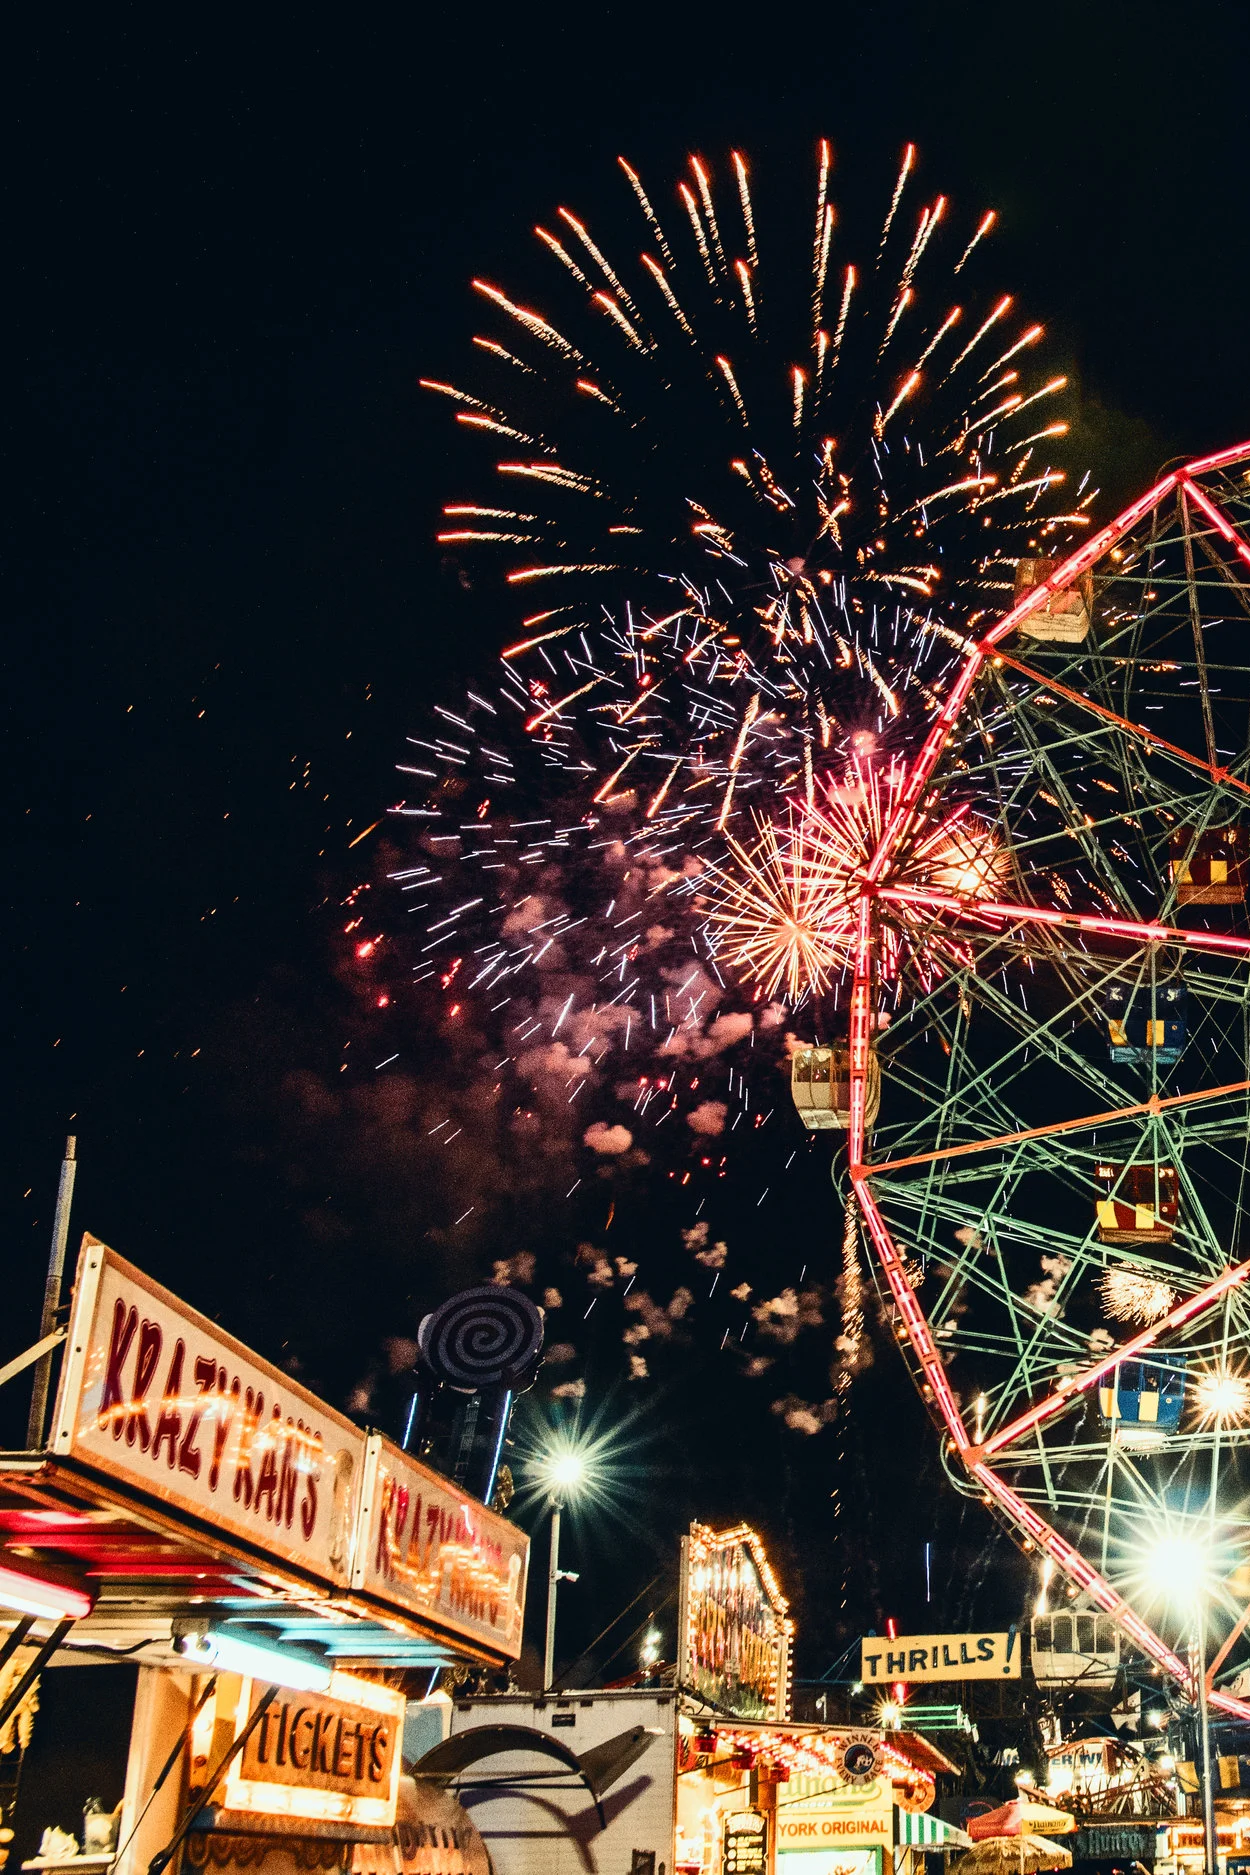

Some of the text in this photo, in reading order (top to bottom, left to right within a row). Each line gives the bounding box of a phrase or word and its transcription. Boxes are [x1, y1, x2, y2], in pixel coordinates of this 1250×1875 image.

[98, 1297, 241, 1492] KRAZY
[257, 1701, 389, 1783] TICKETS
[778, 1822, 818, 1838] YORK
[821, 1819, 889, 1836] ORIGINAL
